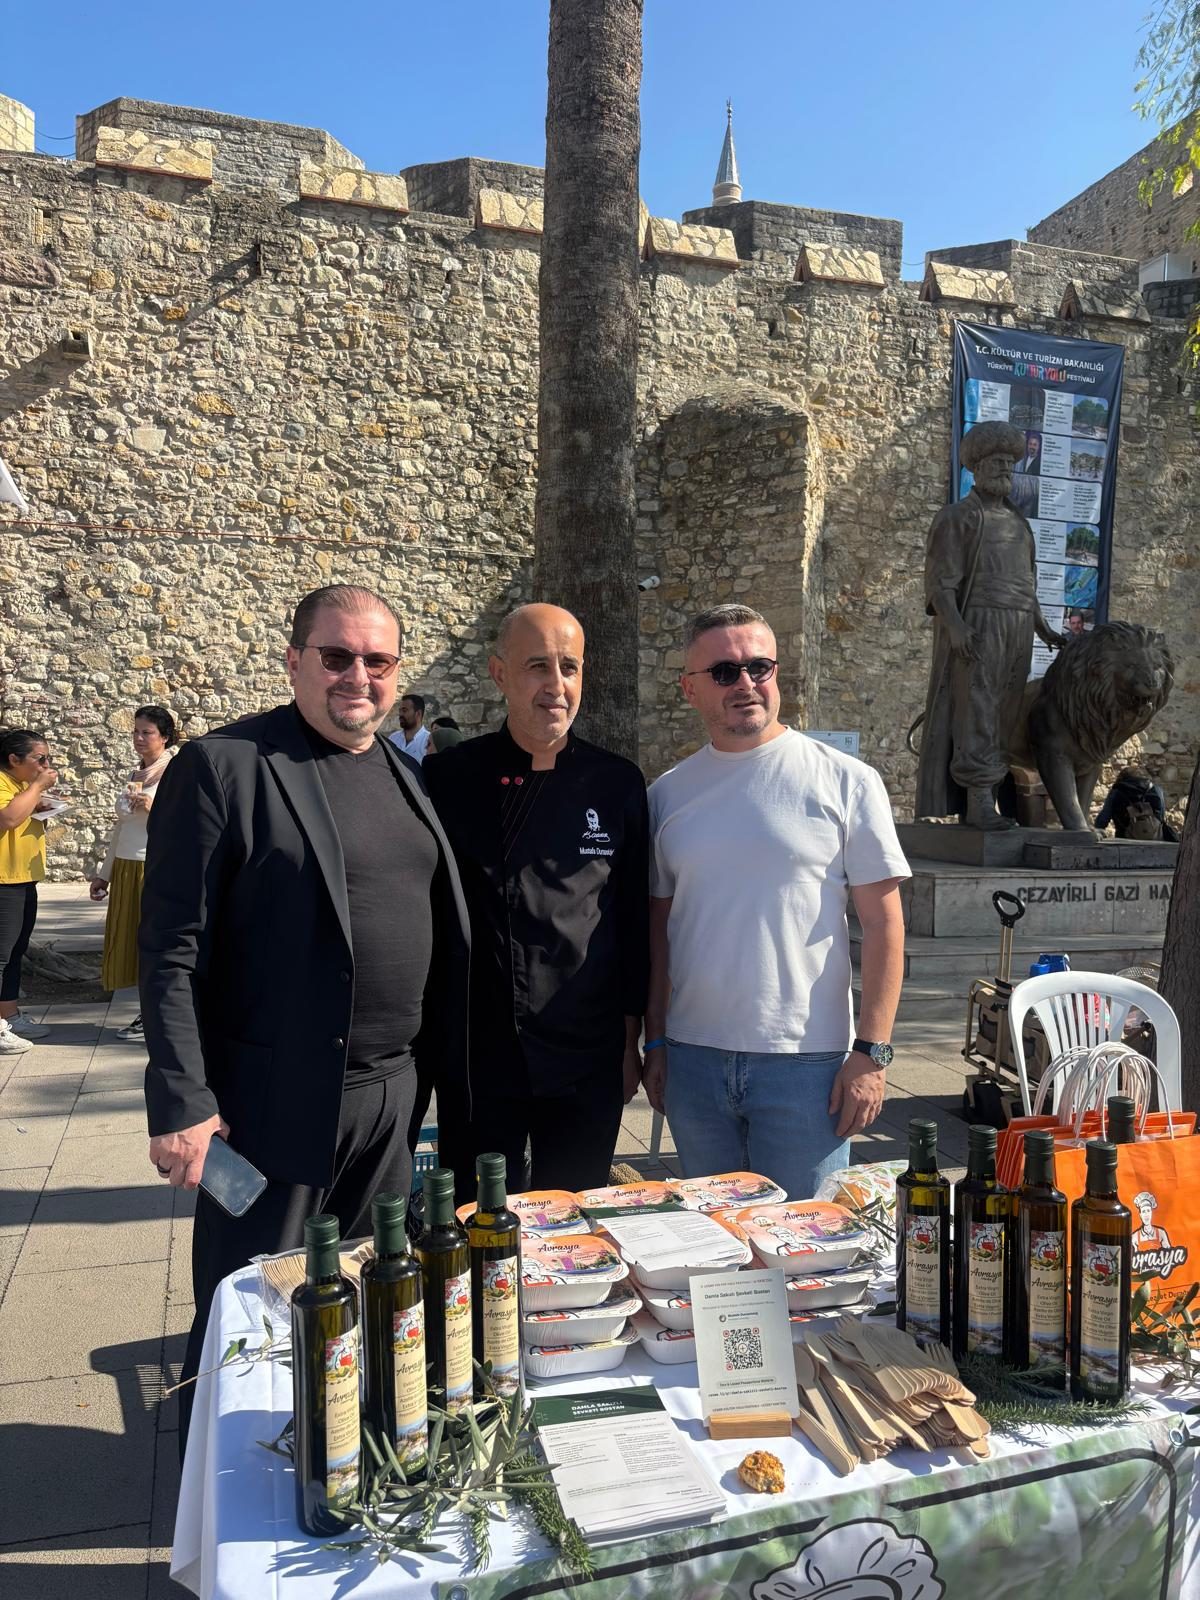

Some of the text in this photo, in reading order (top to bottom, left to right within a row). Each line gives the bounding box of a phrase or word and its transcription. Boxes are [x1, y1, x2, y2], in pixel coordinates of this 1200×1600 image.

[975, 345, 1104, 372] T.C. KÜLTÜR VE TURİZM BAKANLIĞI
[1017, 882, 1096, 903] CEZAYİRLİ
[1105, 882, 1140, 901] GAZİ
[513, 1200, 552, 1210] Avrasya
[782, 1211, 821, 1221] Avrasya
[537, 1243, 580, 1253] Avrasya
[1132, 1249, 1185, 1277] vrasya
[970, 1267, 1002, 1283] Avrasya
[484, 1308, 516, 1320] Avrasya
[571, 1402, 596, 1411] DAMLA
